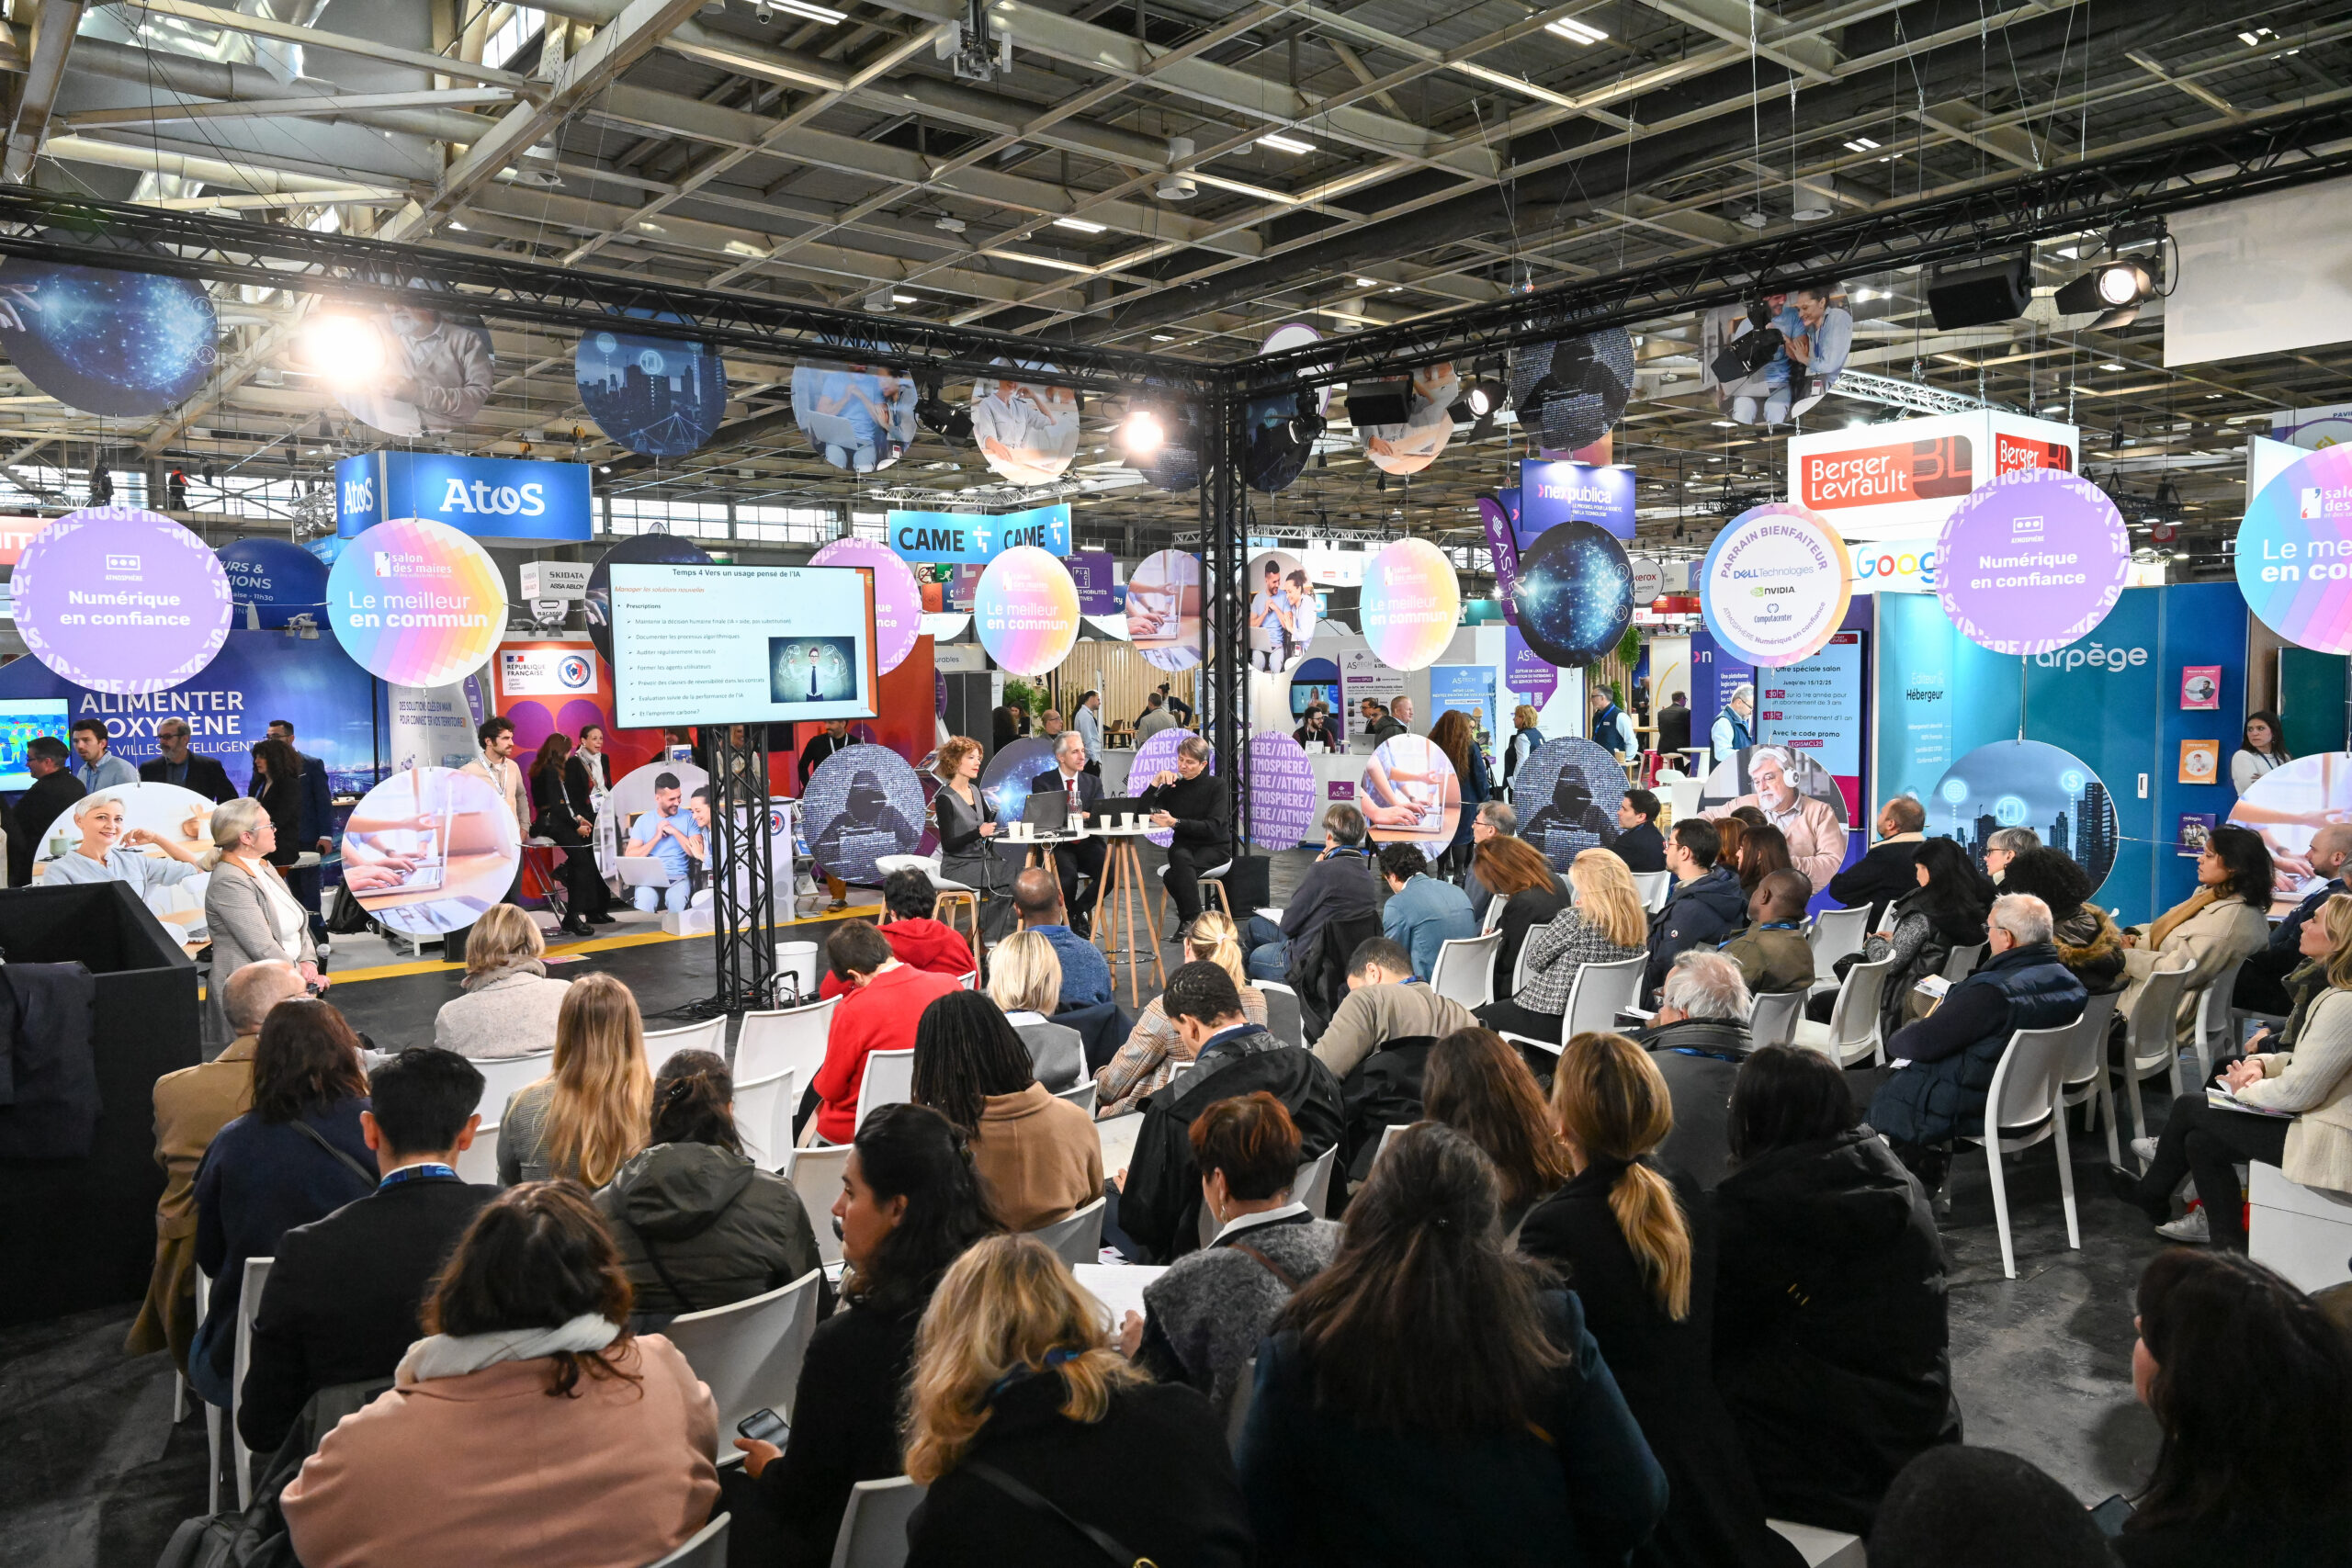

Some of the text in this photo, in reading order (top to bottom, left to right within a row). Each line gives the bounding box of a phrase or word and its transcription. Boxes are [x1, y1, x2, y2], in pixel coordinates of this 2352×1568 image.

[2000, 442, 2040, 469] Berger
[1812, 455, 1891, 482] Berger
[1812, 469, 1906, 502] Levrault
[344, 477, 374, 514] Atos
[439, 479, 546, 516] Atos
[1544, 485, 1612, 504] nexpublica
[2325, 501, 2350, 512] des
[899, 526, 966, 552] CAME
[1004, 525, 1046, 549] CAME
[392, 552, 424, 563] salon
[1720, 525, 1828, 579] PARRAIN BIENFAITEUR
[2263, 539, 2297, 560] Le
[222, 560, 264, 574] URS &
[392, 563, 453, 574] des maires
[1857, 547, 1937, 583] Goog
[1979, 552, 2077, 570] Numérique
[548, 571, 584, 580] SKIDATA
[673, 569, 697, 577] Temps
[1734, 566, 1815, 580] DELL Technologies
[1971, 571, 2086, 589] en confiance
[2261, 565, 2300, 581] en
[69, 591, 181, 609] Numérique
[348, 591, 471, 610] Le meilleur
[1370, 595, 1437, 612] Le meilleur
[987, 602, 1058, 616] Le meilleur
[60, 611, 191, 626] en confiance
[350, 613, 489, 627] en commun
[987, 618, 1069, 631] en commun
[1370, 611, 1448, 626] en commun
[1754, 614, 1792, 625] Computacenter
[2034, 642, 2148, 672] arpège
[1792, 665, 1821, 673] spéciale
[79, 692, 244, 714] ALIMENTER
[1905, 688, 1943, 702] Hébergeur
[117, 743, 162, 756] VILLES
